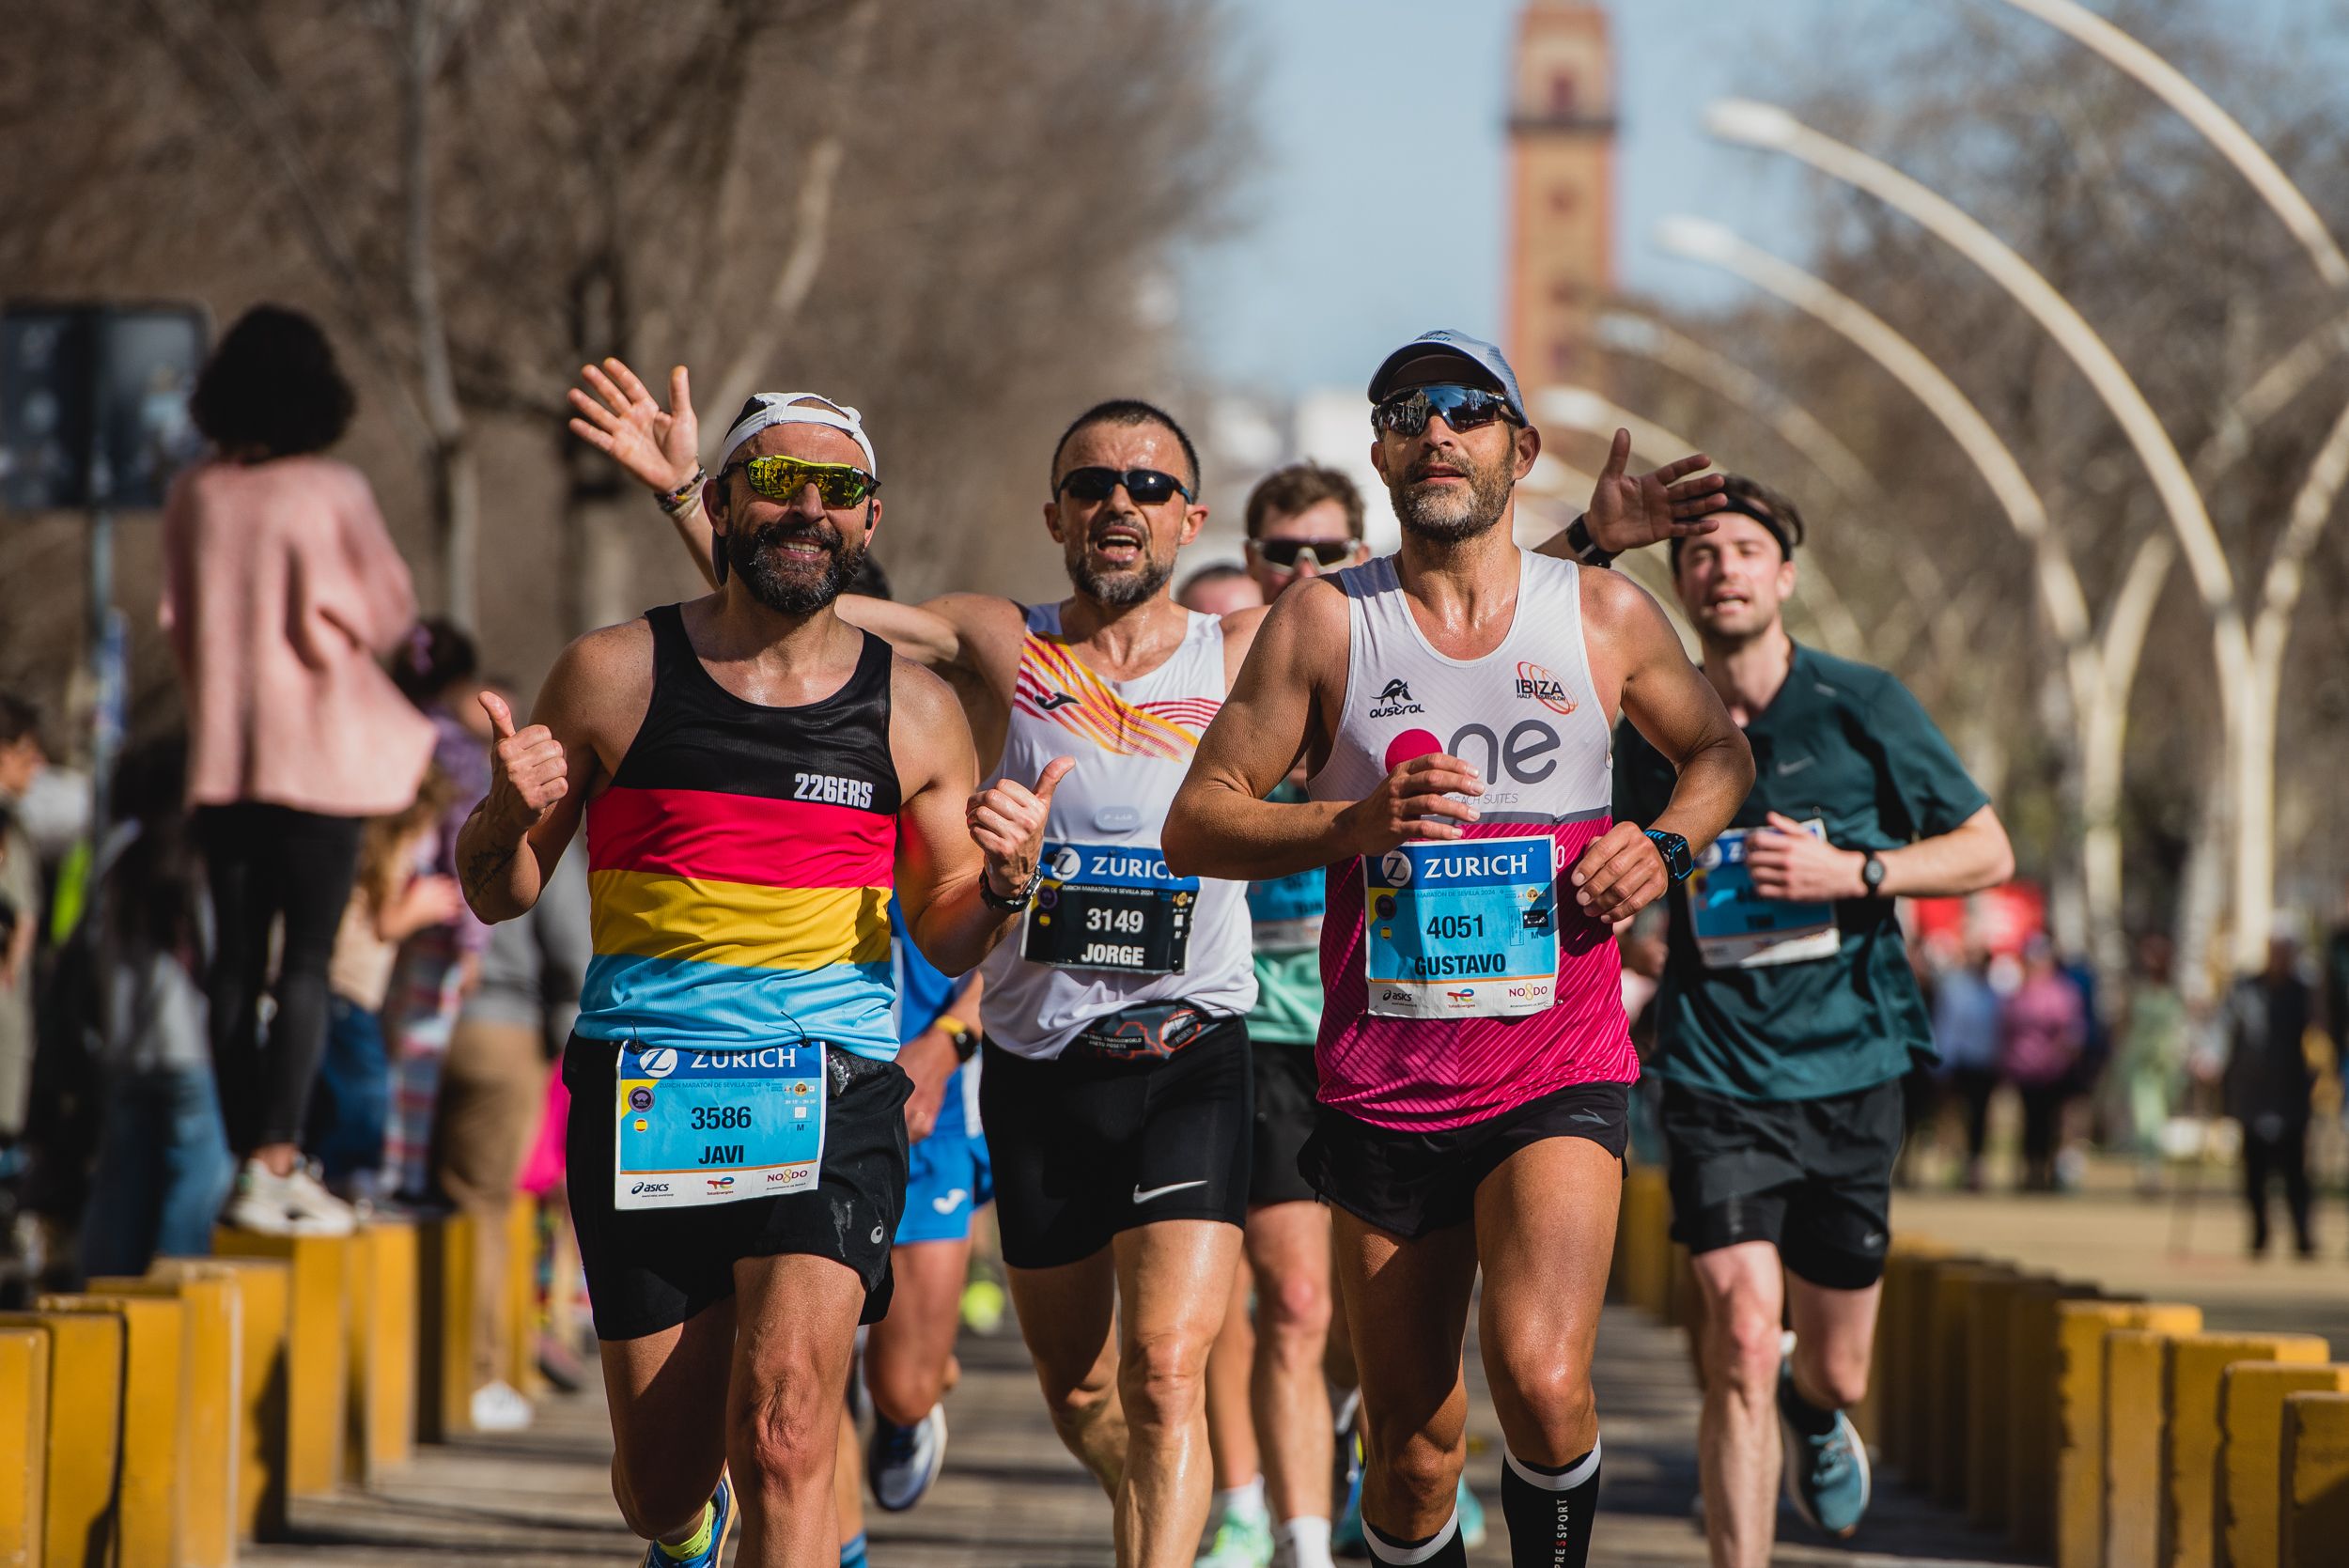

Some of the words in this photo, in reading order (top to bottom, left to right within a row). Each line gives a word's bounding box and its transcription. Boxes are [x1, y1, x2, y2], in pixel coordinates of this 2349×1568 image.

[1516, 679, 1564, 696] IBIZA
[793, 772, 873, 809] 226ERS
[1484, 792, 1518, 805] SUITES
[1091, 856, 1182, 880] ZURIC
[1424, 854, 1528, 879] ZURICH
[1085, 908, 1144, 934] 3149
[1426, 914, 1485, 939] 4051
[1081, 943, 1144, 966] JORGE
[1414, 953, 1506, 976] GUSTAVO
[1392, 992, 1412, 1001] asics
[691, 1048, 797, 1069] ZURICH
[691, 1106, 752, 1130] 3586
[796, 1124, 804, 1132] M
[698, 1144, 744, 1164] JAVI
[644, 1183, 669, 1192] asics
